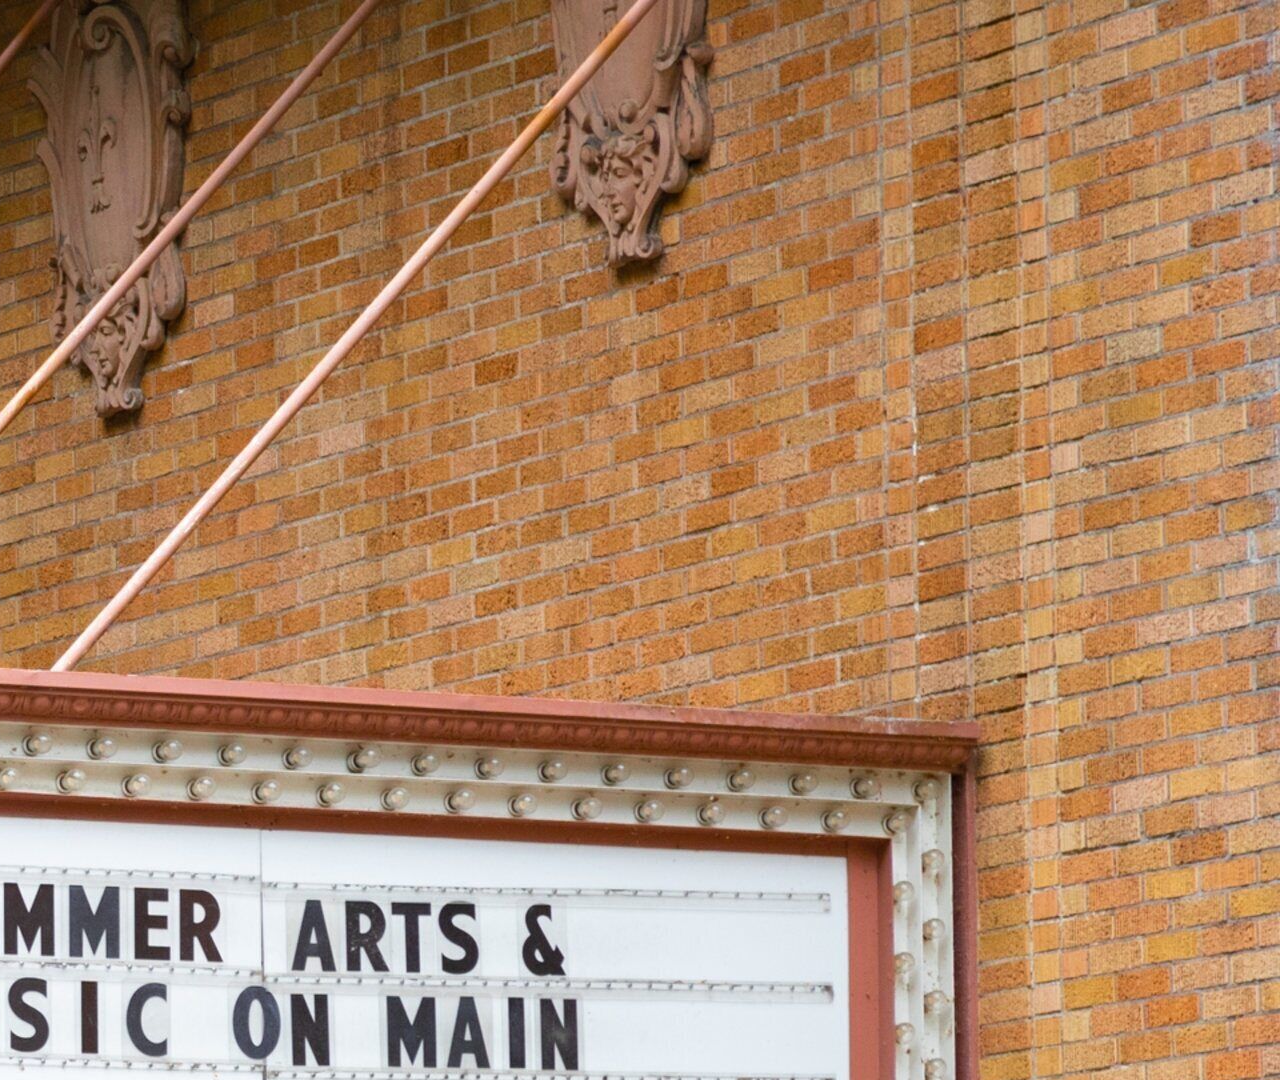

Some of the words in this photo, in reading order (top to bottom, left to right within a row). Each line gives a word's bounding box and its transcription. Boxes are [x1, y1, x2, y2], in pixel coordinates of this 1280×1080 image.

[291, 899, 479, 975] ARTS
[522, 903, 565, 976] &
[232, 985, 330, 1066] ON
[387, 996, 578, 1071] MAIN
